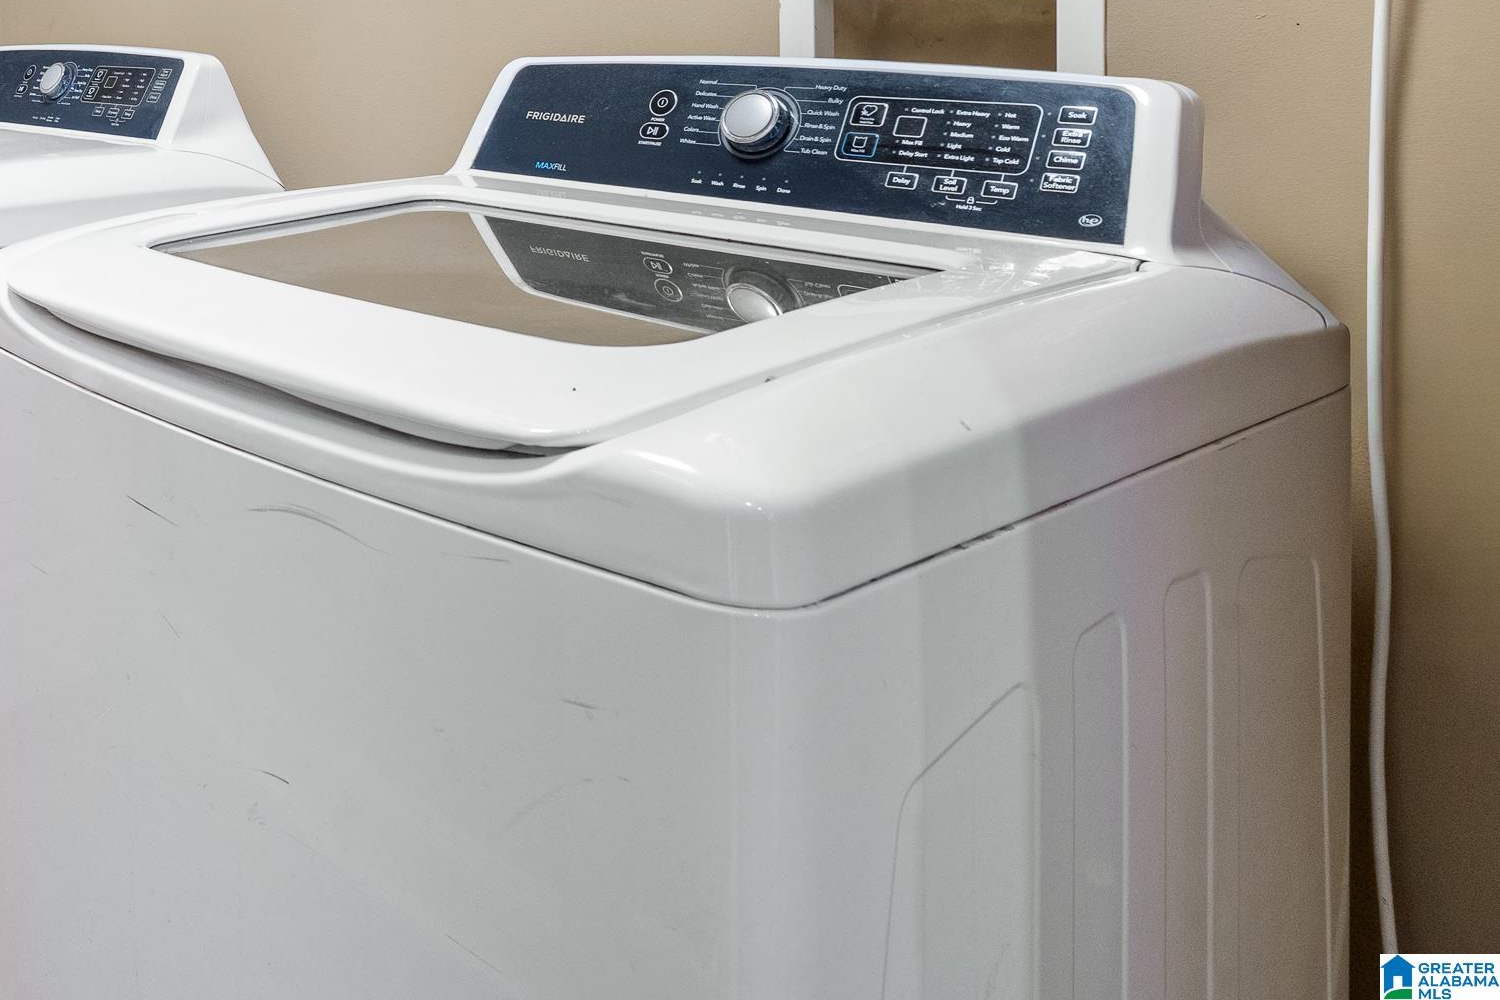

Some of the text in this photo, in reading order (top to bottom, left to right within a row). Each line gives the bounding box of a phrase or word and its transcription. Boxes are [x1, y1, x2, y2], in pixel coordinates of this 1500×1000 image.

[815, 84, 833, 92] Heavy
[526, 110, 586, 124] FRIGIDAIRE
[970, 110, 990, 118] Heavy
[1067, 111, 1087, 119] Soak
[953, 120, 972, 128] Heavy
[1060, 136, 1082, 144] Rinse
[1053, 156, 1078, 164] Chime
[535, 161, 567, 172] MAXFILL
[892, 176, 911, 185] Delay
[1049, 175, 1073, 184] Fabric
[939, 184, 958, 192] Level
[989, 185, 1010, 195] Temp
[1043, 182, 1076, 191] Softener
